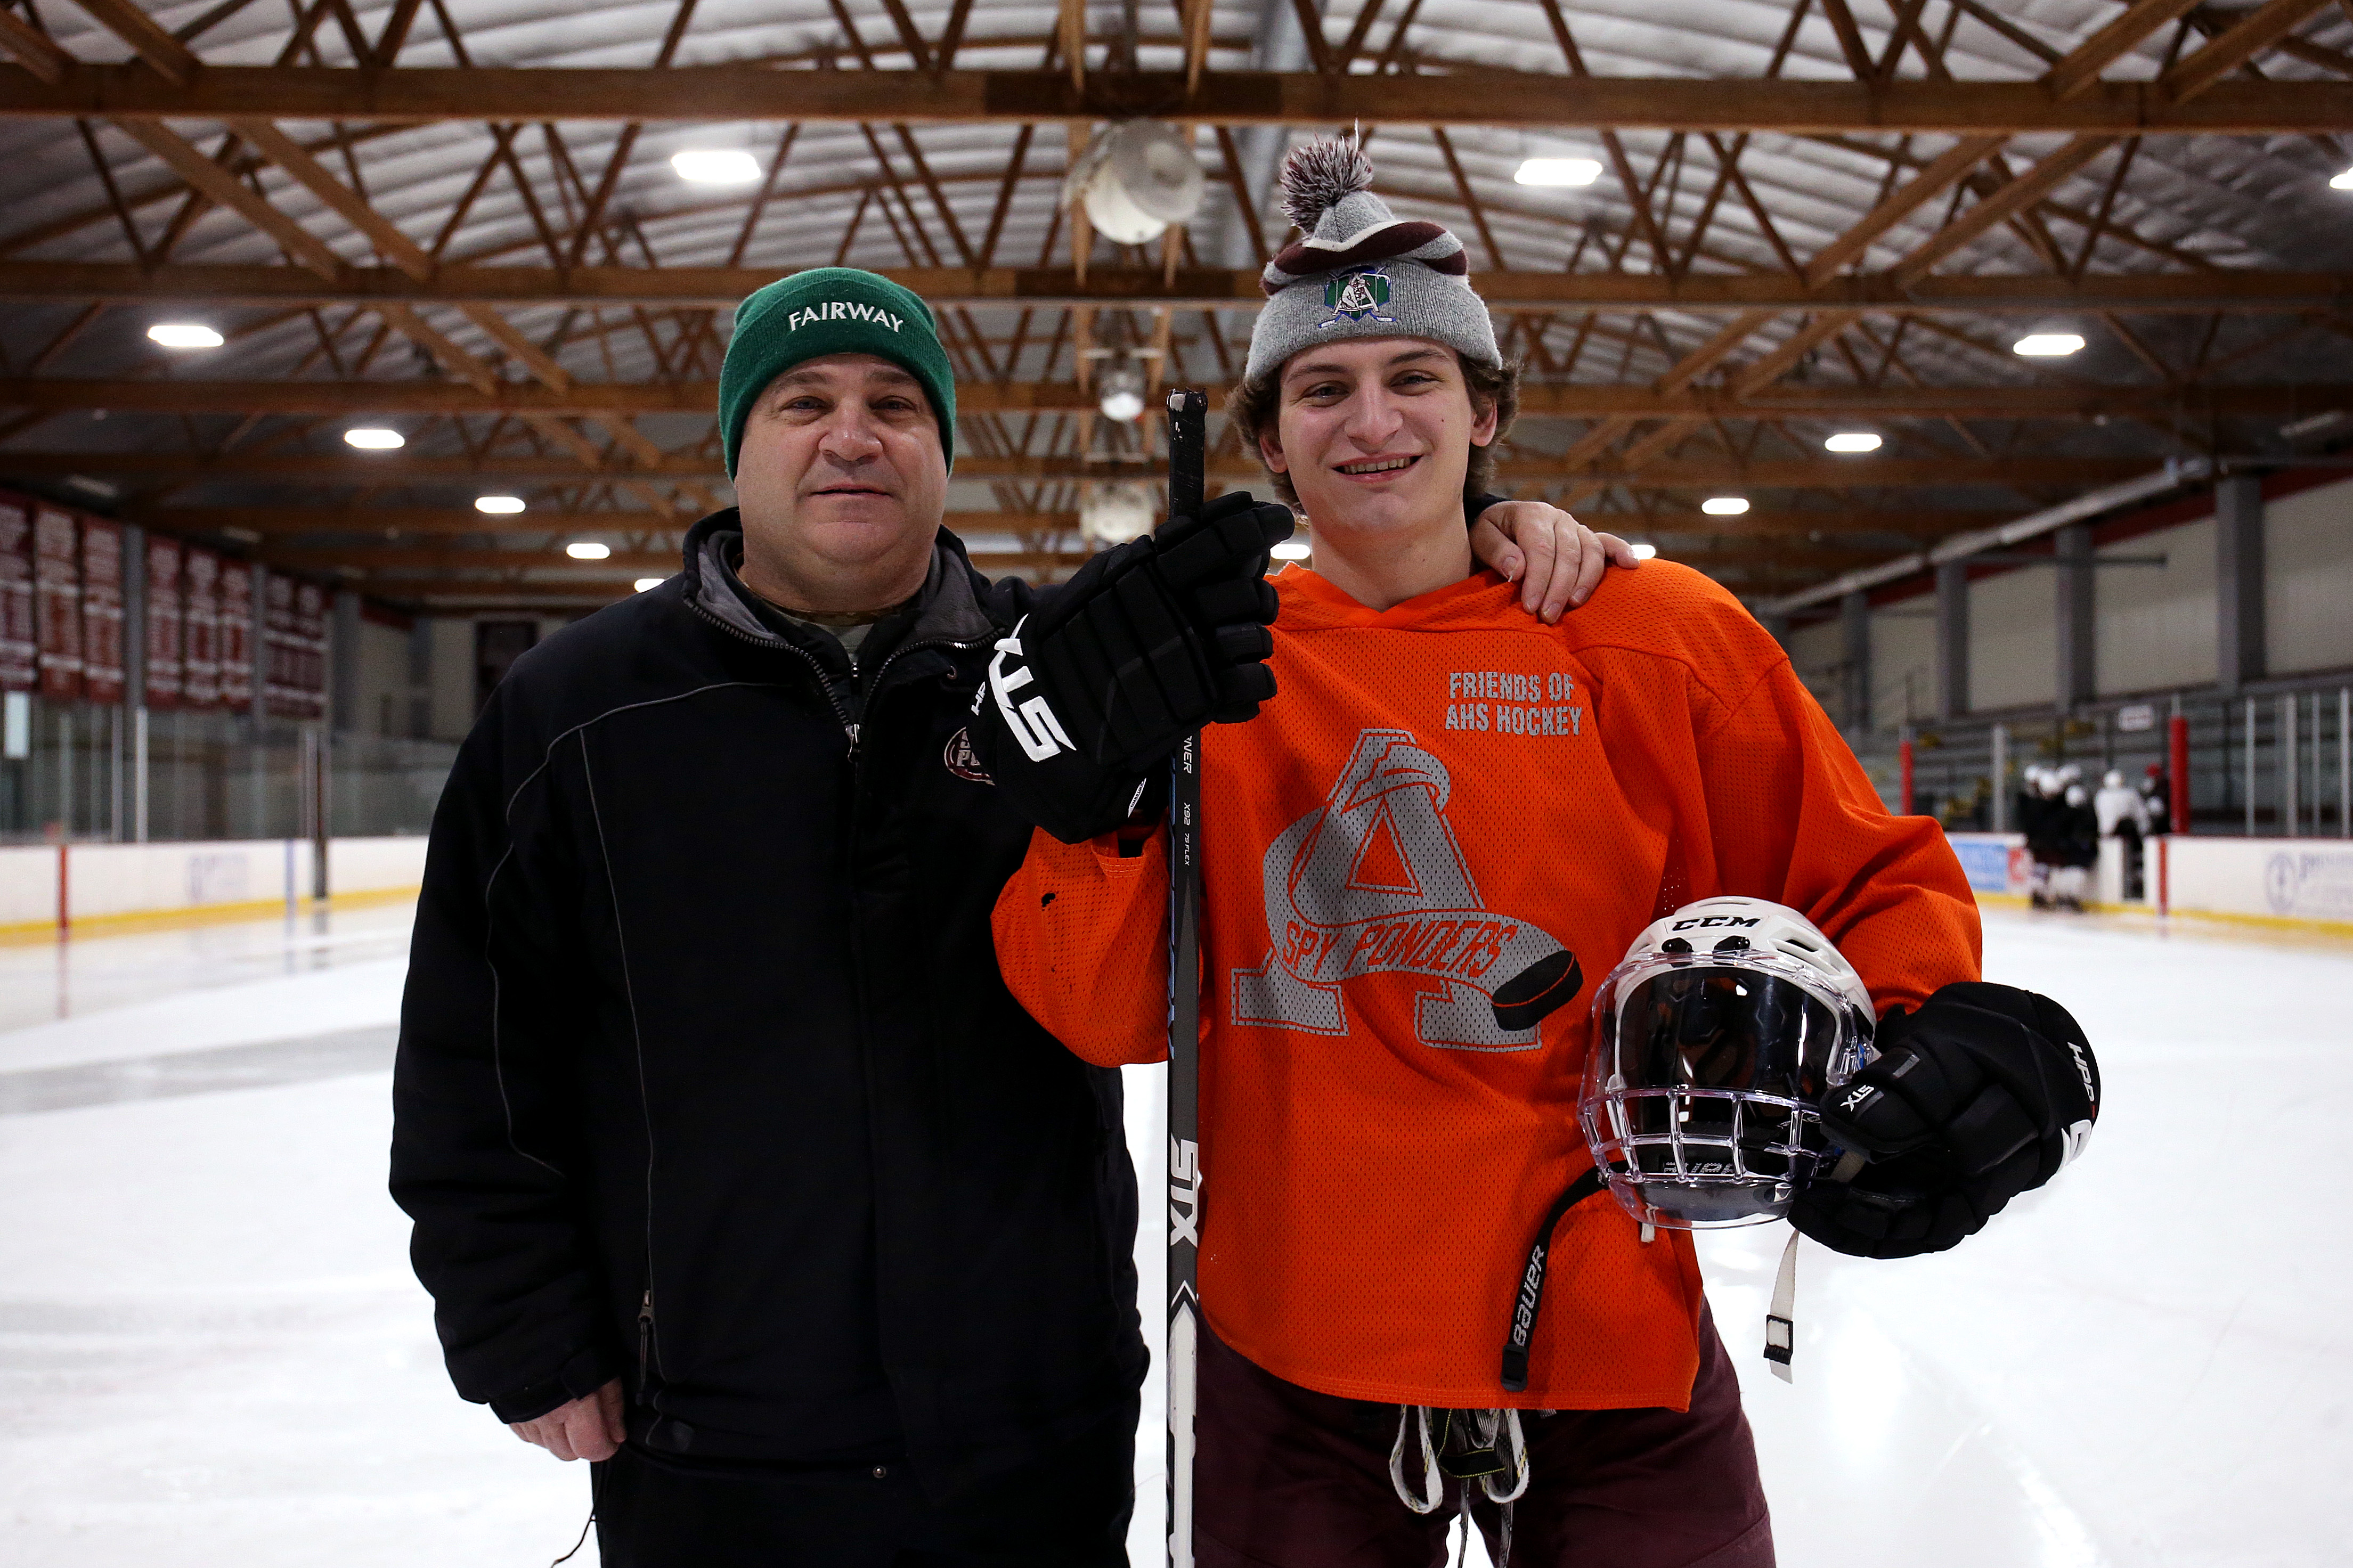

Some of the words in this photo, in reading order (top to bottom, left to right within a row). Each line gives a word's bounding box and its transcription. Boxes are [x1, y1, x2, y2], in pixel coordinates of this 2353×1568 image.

[788, 301, 904, 333] FAIRWAY
[988, 613, 1077, 763] STX
[1449, 671, 1542, 704] FRIENDS
[1548, 672, 1575, 701] OF
[1445, 703, 1490, 732] AHS
[1496, 704, 1583, 737] HOCKEY
[1672, 916, 1762, 932] CCM
[1282, 920, 1343, 977] SPY
[1342, 919, 1519, 979] PONDERS
[1839, 1084, 1875, 1112] STX
[1170, 1132, 1199, 1249] STX
